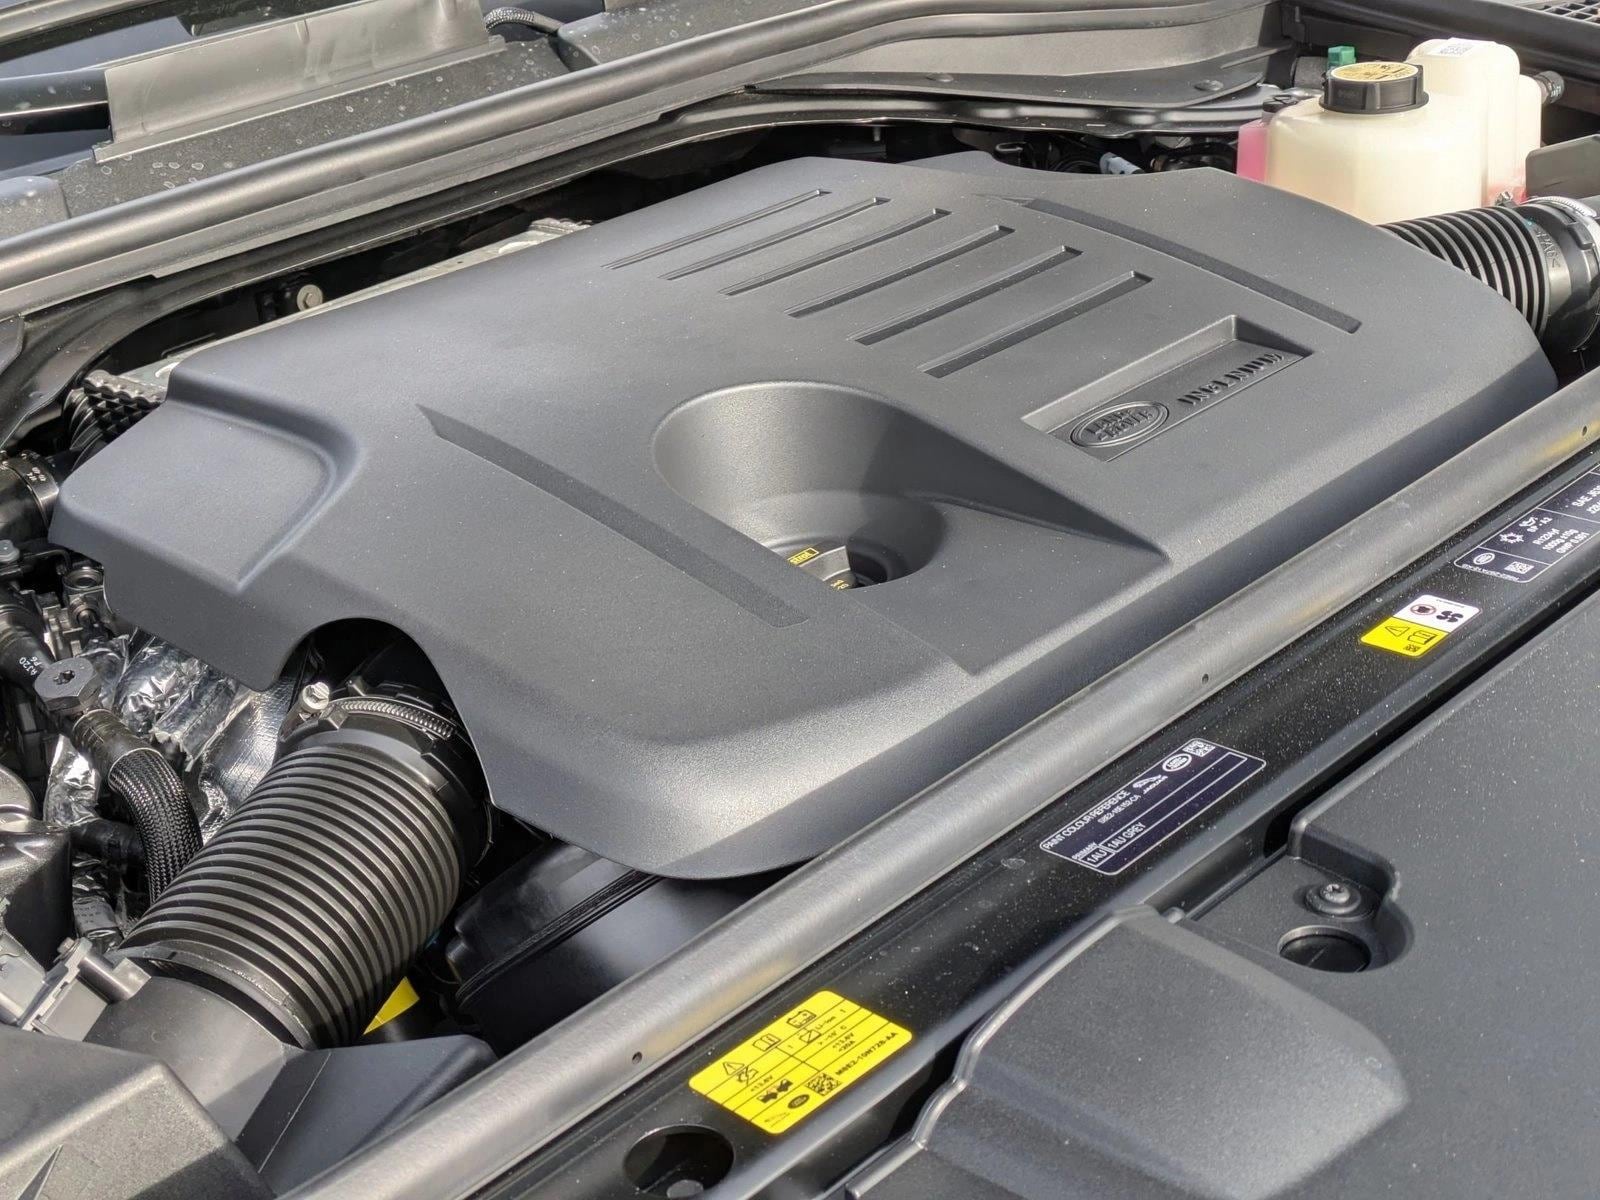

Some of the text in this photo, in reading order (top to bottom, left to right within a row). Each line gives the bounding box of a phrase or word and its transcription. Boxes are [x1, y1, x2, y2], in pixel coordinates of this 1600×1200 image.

[1177, 353, 1284, 406] INGENIUM
[19, 657, 38, 676] AJ20
[1143, 775, 1169, 795] JAGUAR
[1044, 789, 1131, 849] PAINT COLOUR REFERENCE
[1086, 822, 1147, 864] 1AU 1AU GREY
